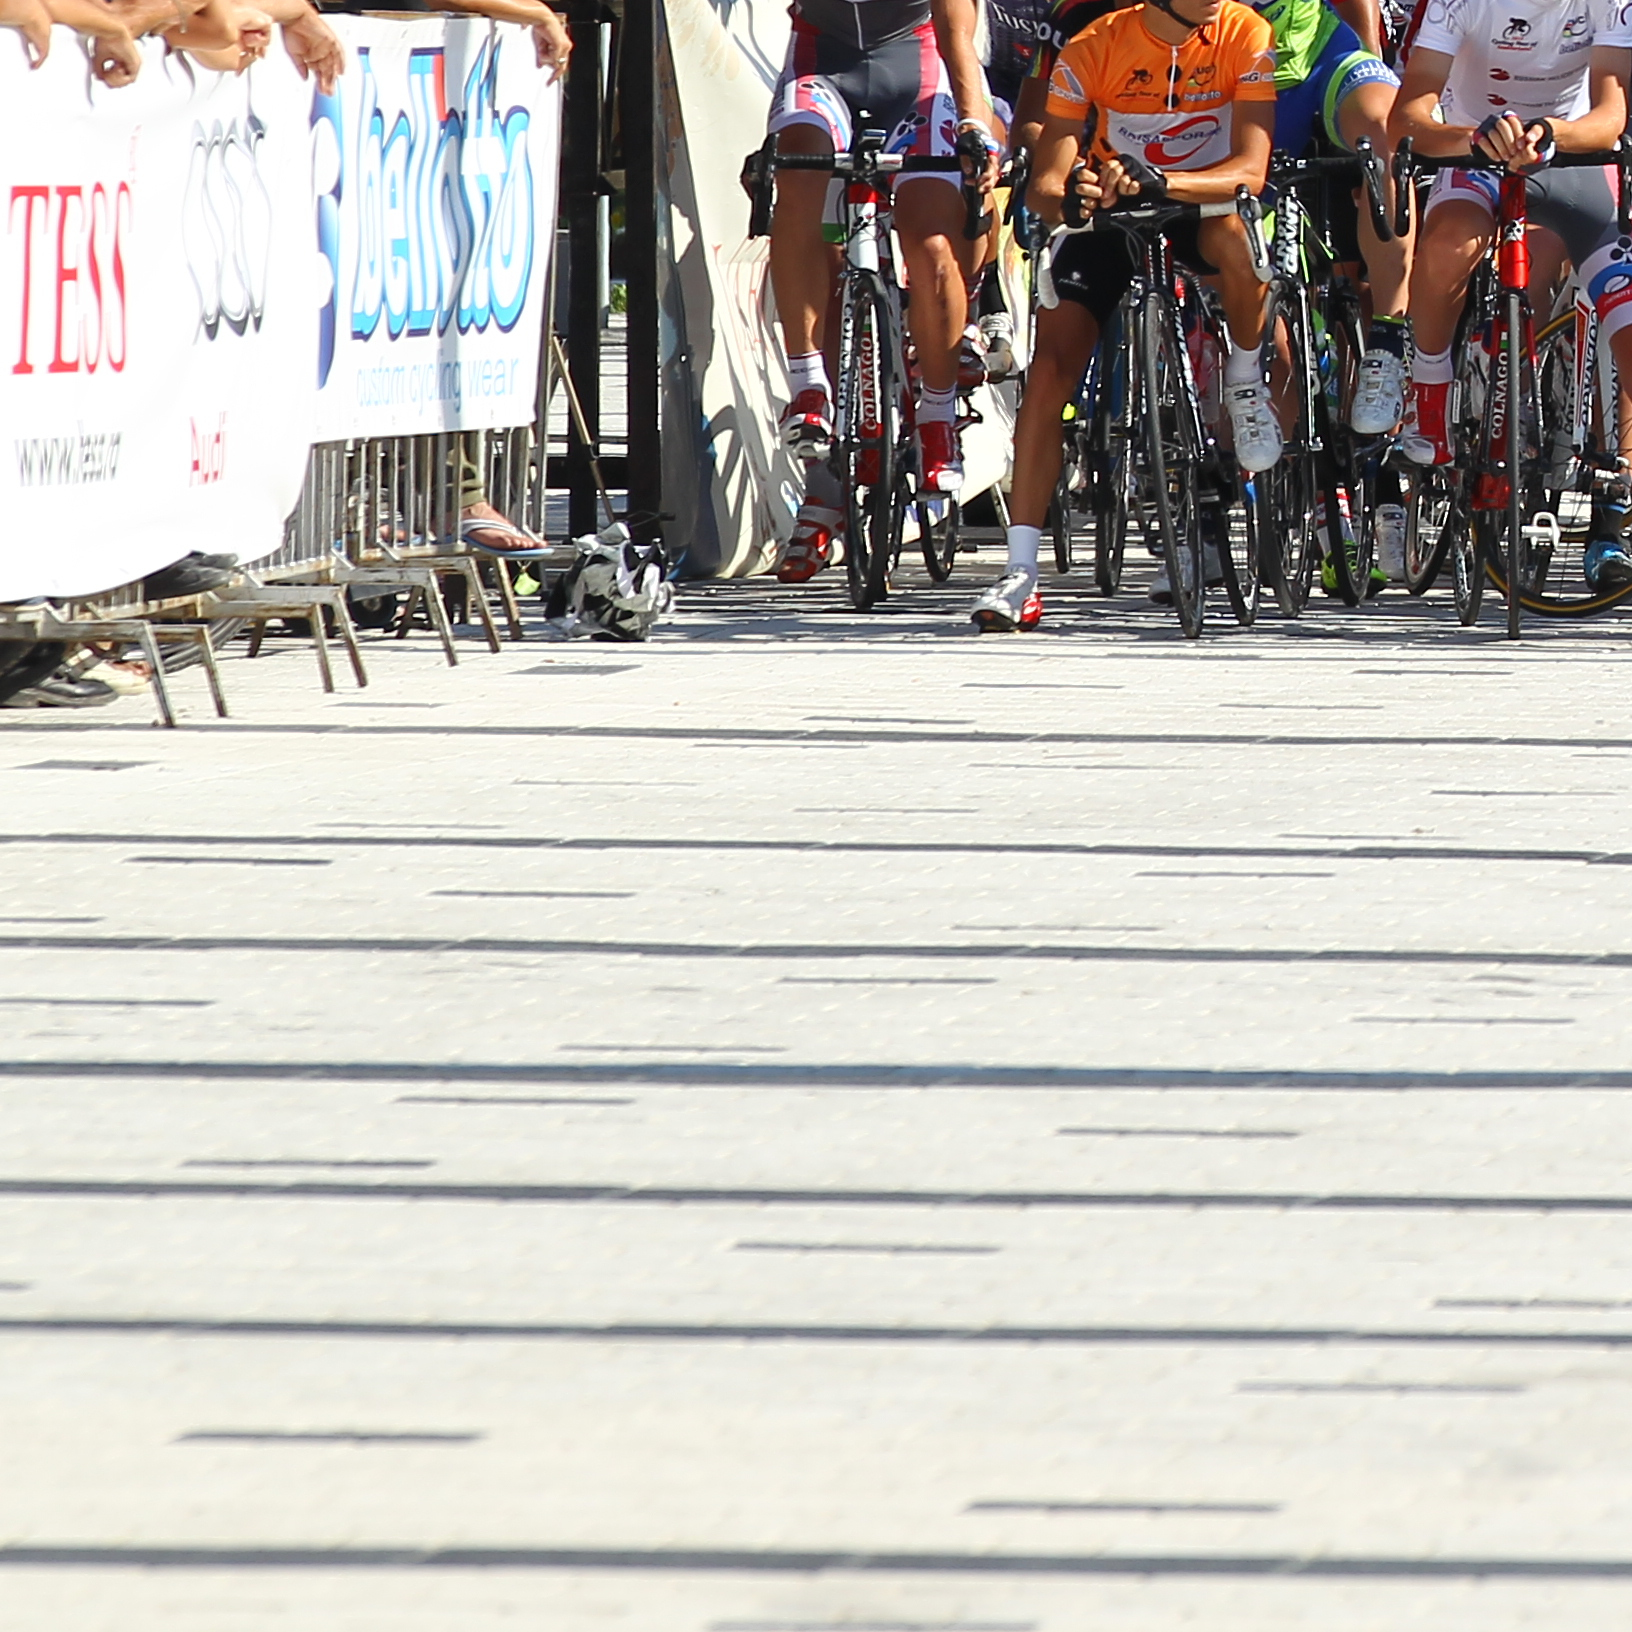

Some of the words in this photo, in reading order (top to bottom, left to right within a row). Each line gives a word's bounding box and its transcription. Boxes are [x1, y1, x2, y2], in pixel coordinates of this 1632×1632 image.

[467, 355, 520, 398] wear
[863, 335, 876, 431] COLNAGO
[1491, 351, 1508, 439] COLNAGO
